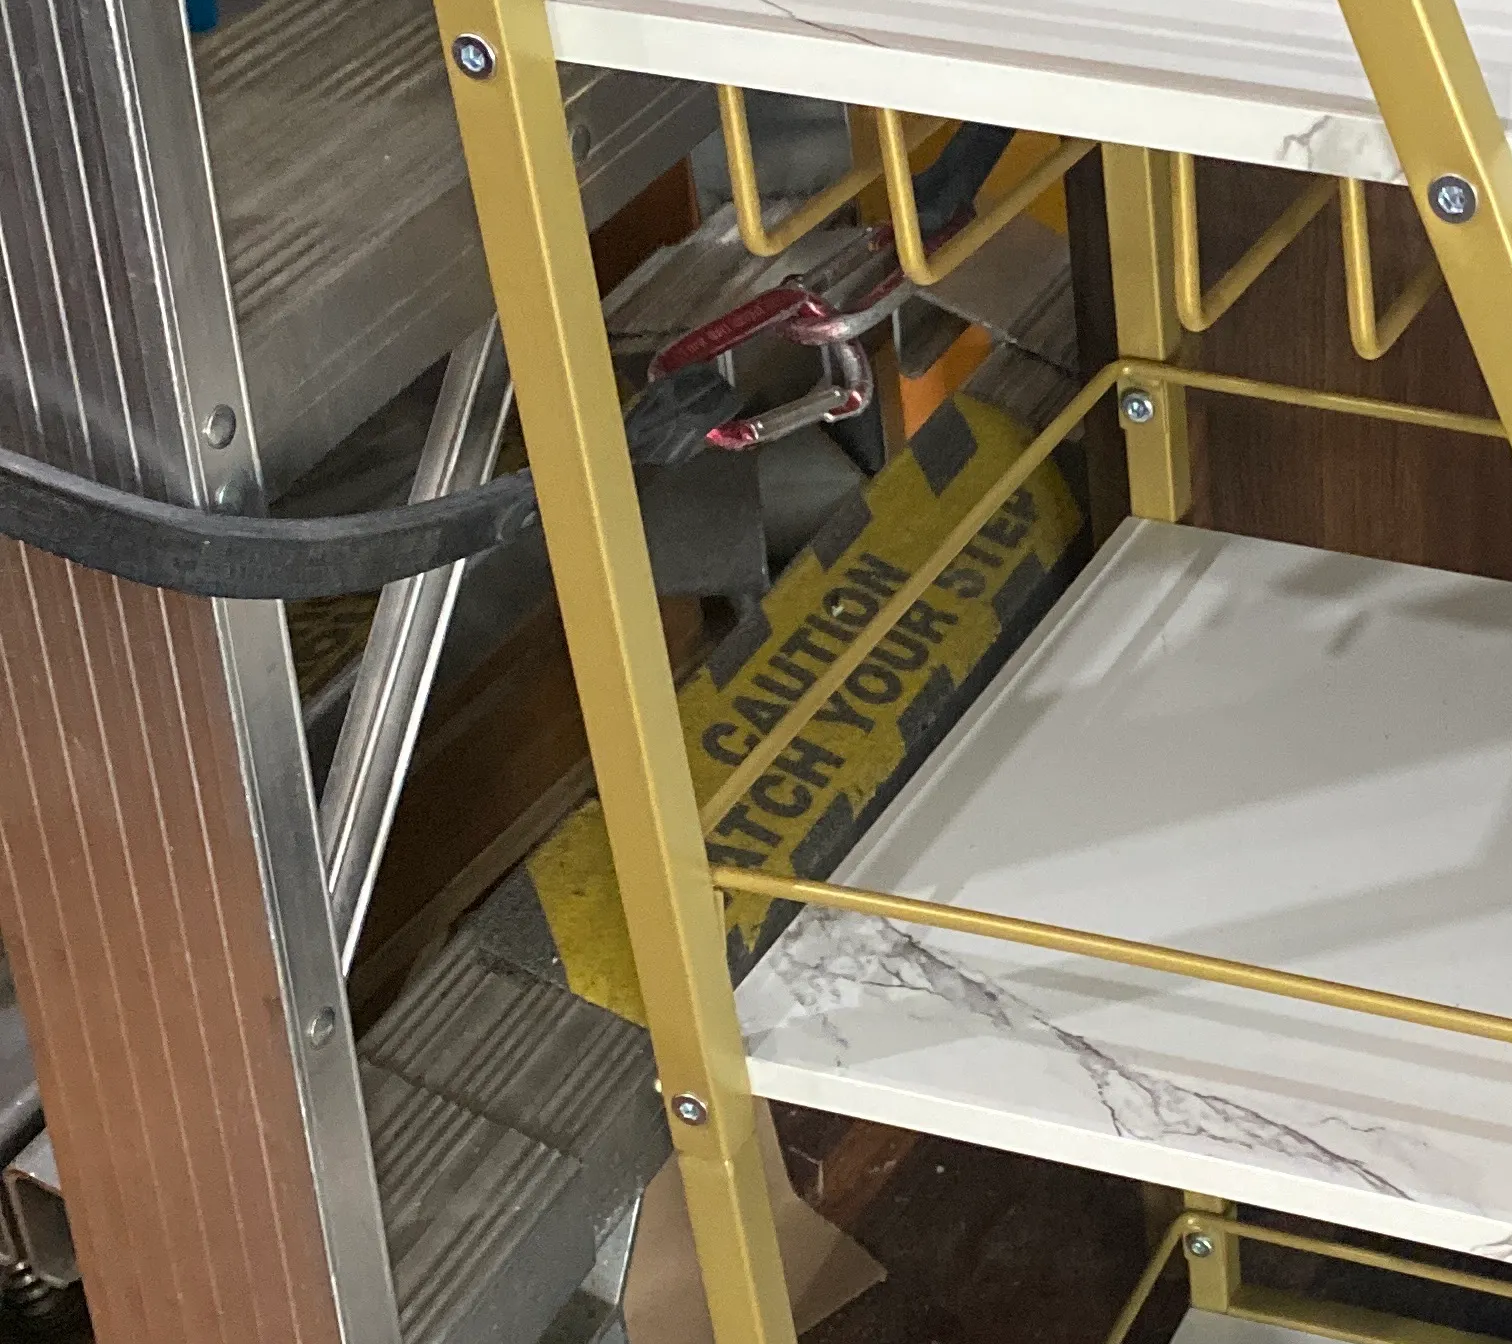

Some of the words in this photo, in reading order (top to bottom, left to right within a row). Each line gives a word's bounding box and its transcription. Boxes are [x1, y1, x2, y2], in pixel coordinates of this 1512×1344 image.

[702, 552, 912, 766] CAUTION
[706, 735, 847, 909] ATCH
[811, 599, 959, 735] YOUR
